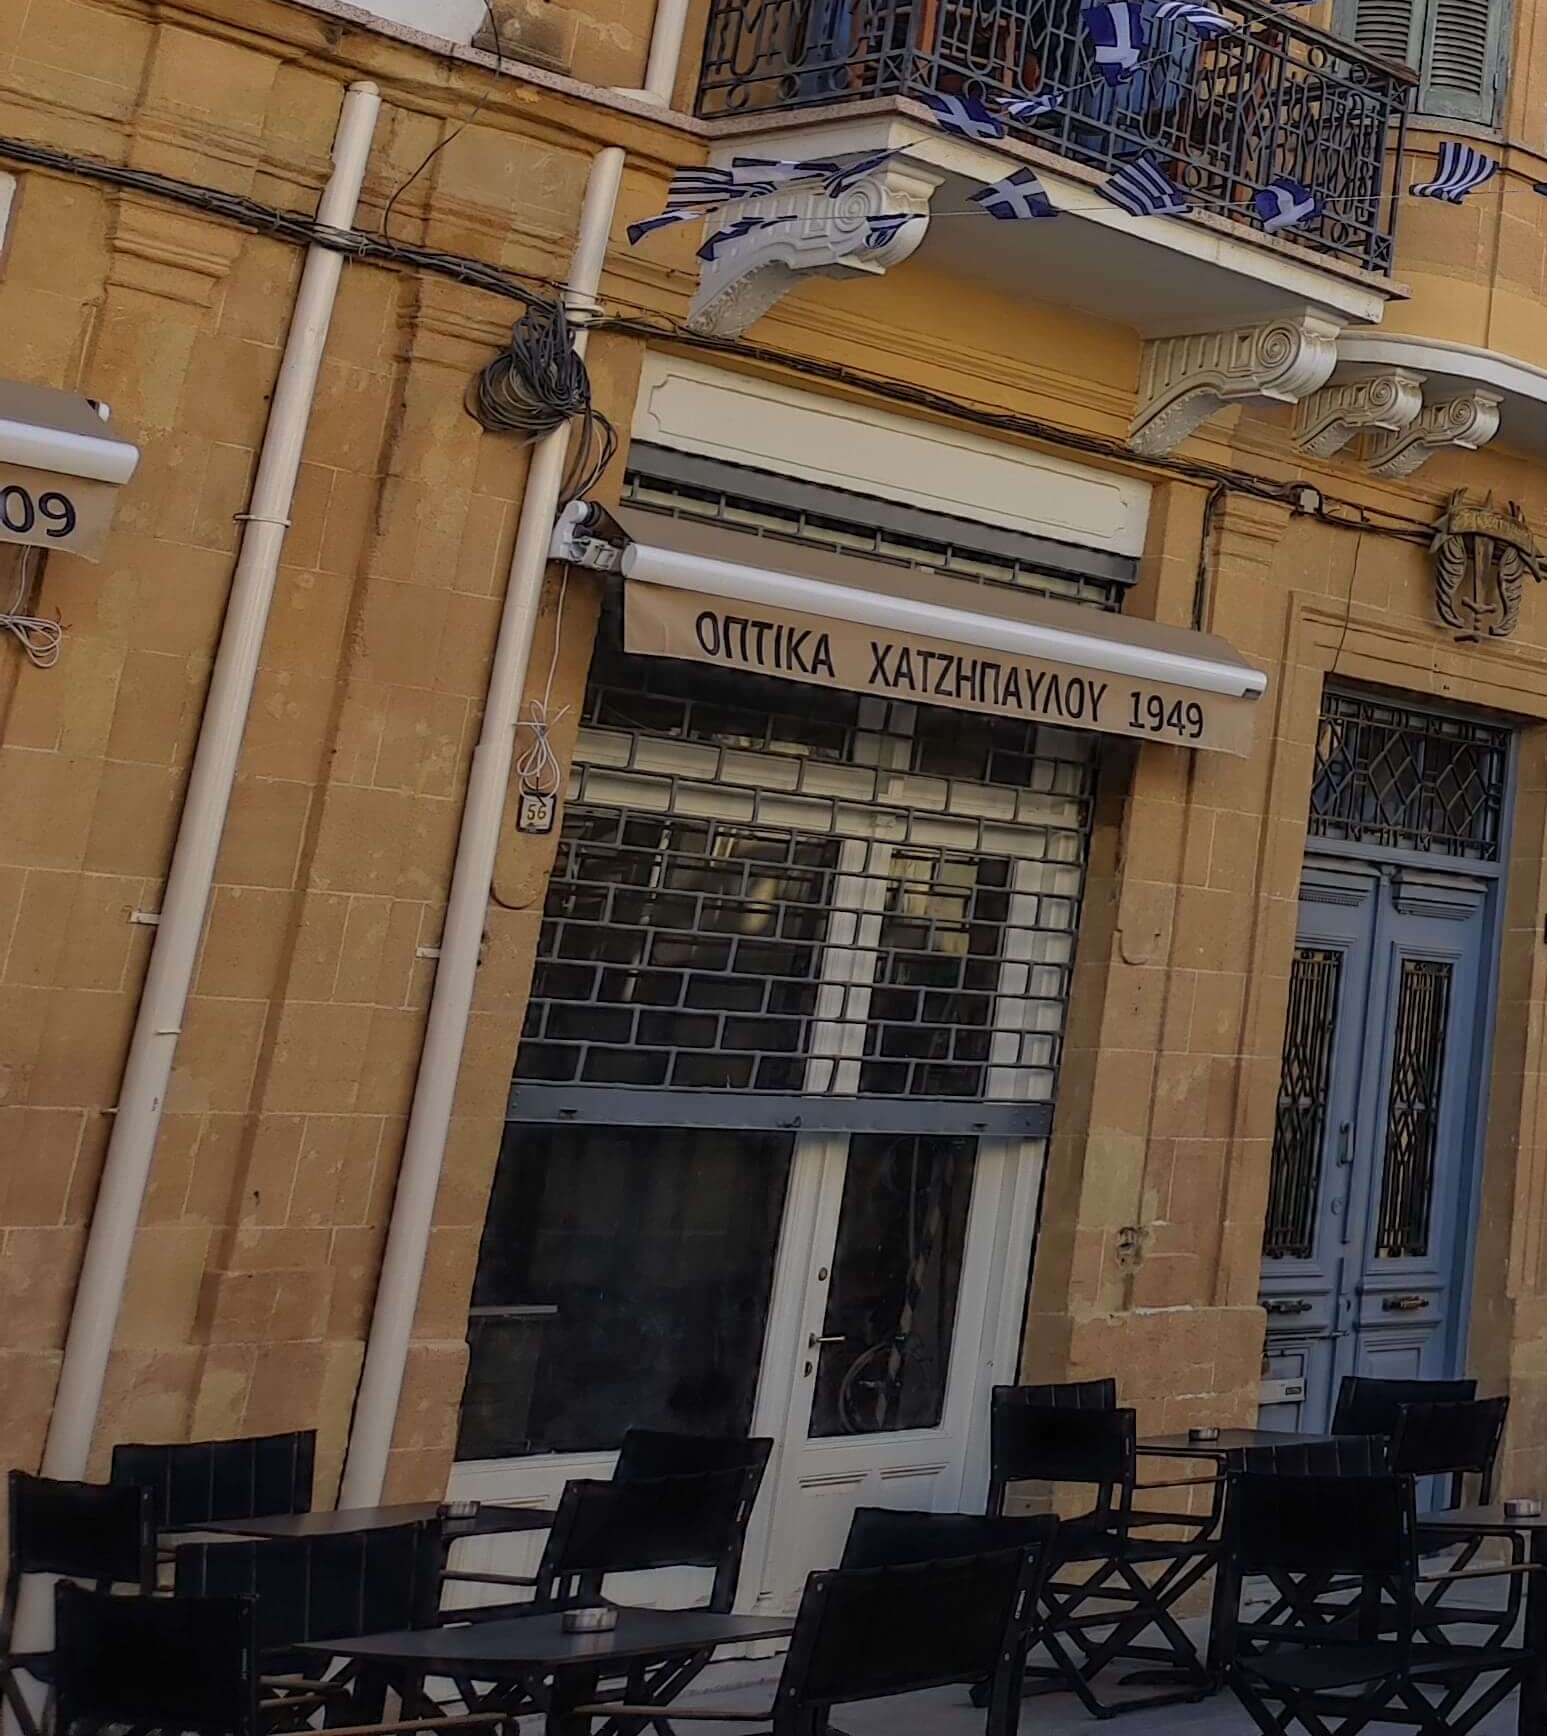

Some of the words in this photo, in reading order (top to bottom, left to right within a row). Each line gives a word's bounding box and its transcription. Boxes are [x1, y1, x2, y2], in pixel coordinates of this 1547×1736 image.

[0, 485, 76, 538] 09
[695, 610, 836, 678] ΟΠΤΙΚΑ
[868, 640, 1107, 722] ΧΑΤΖΗΠΑΥΛΟΥ
[1127, 691, 1204, 739] 1949
[527, 804, 546, 821] 56
